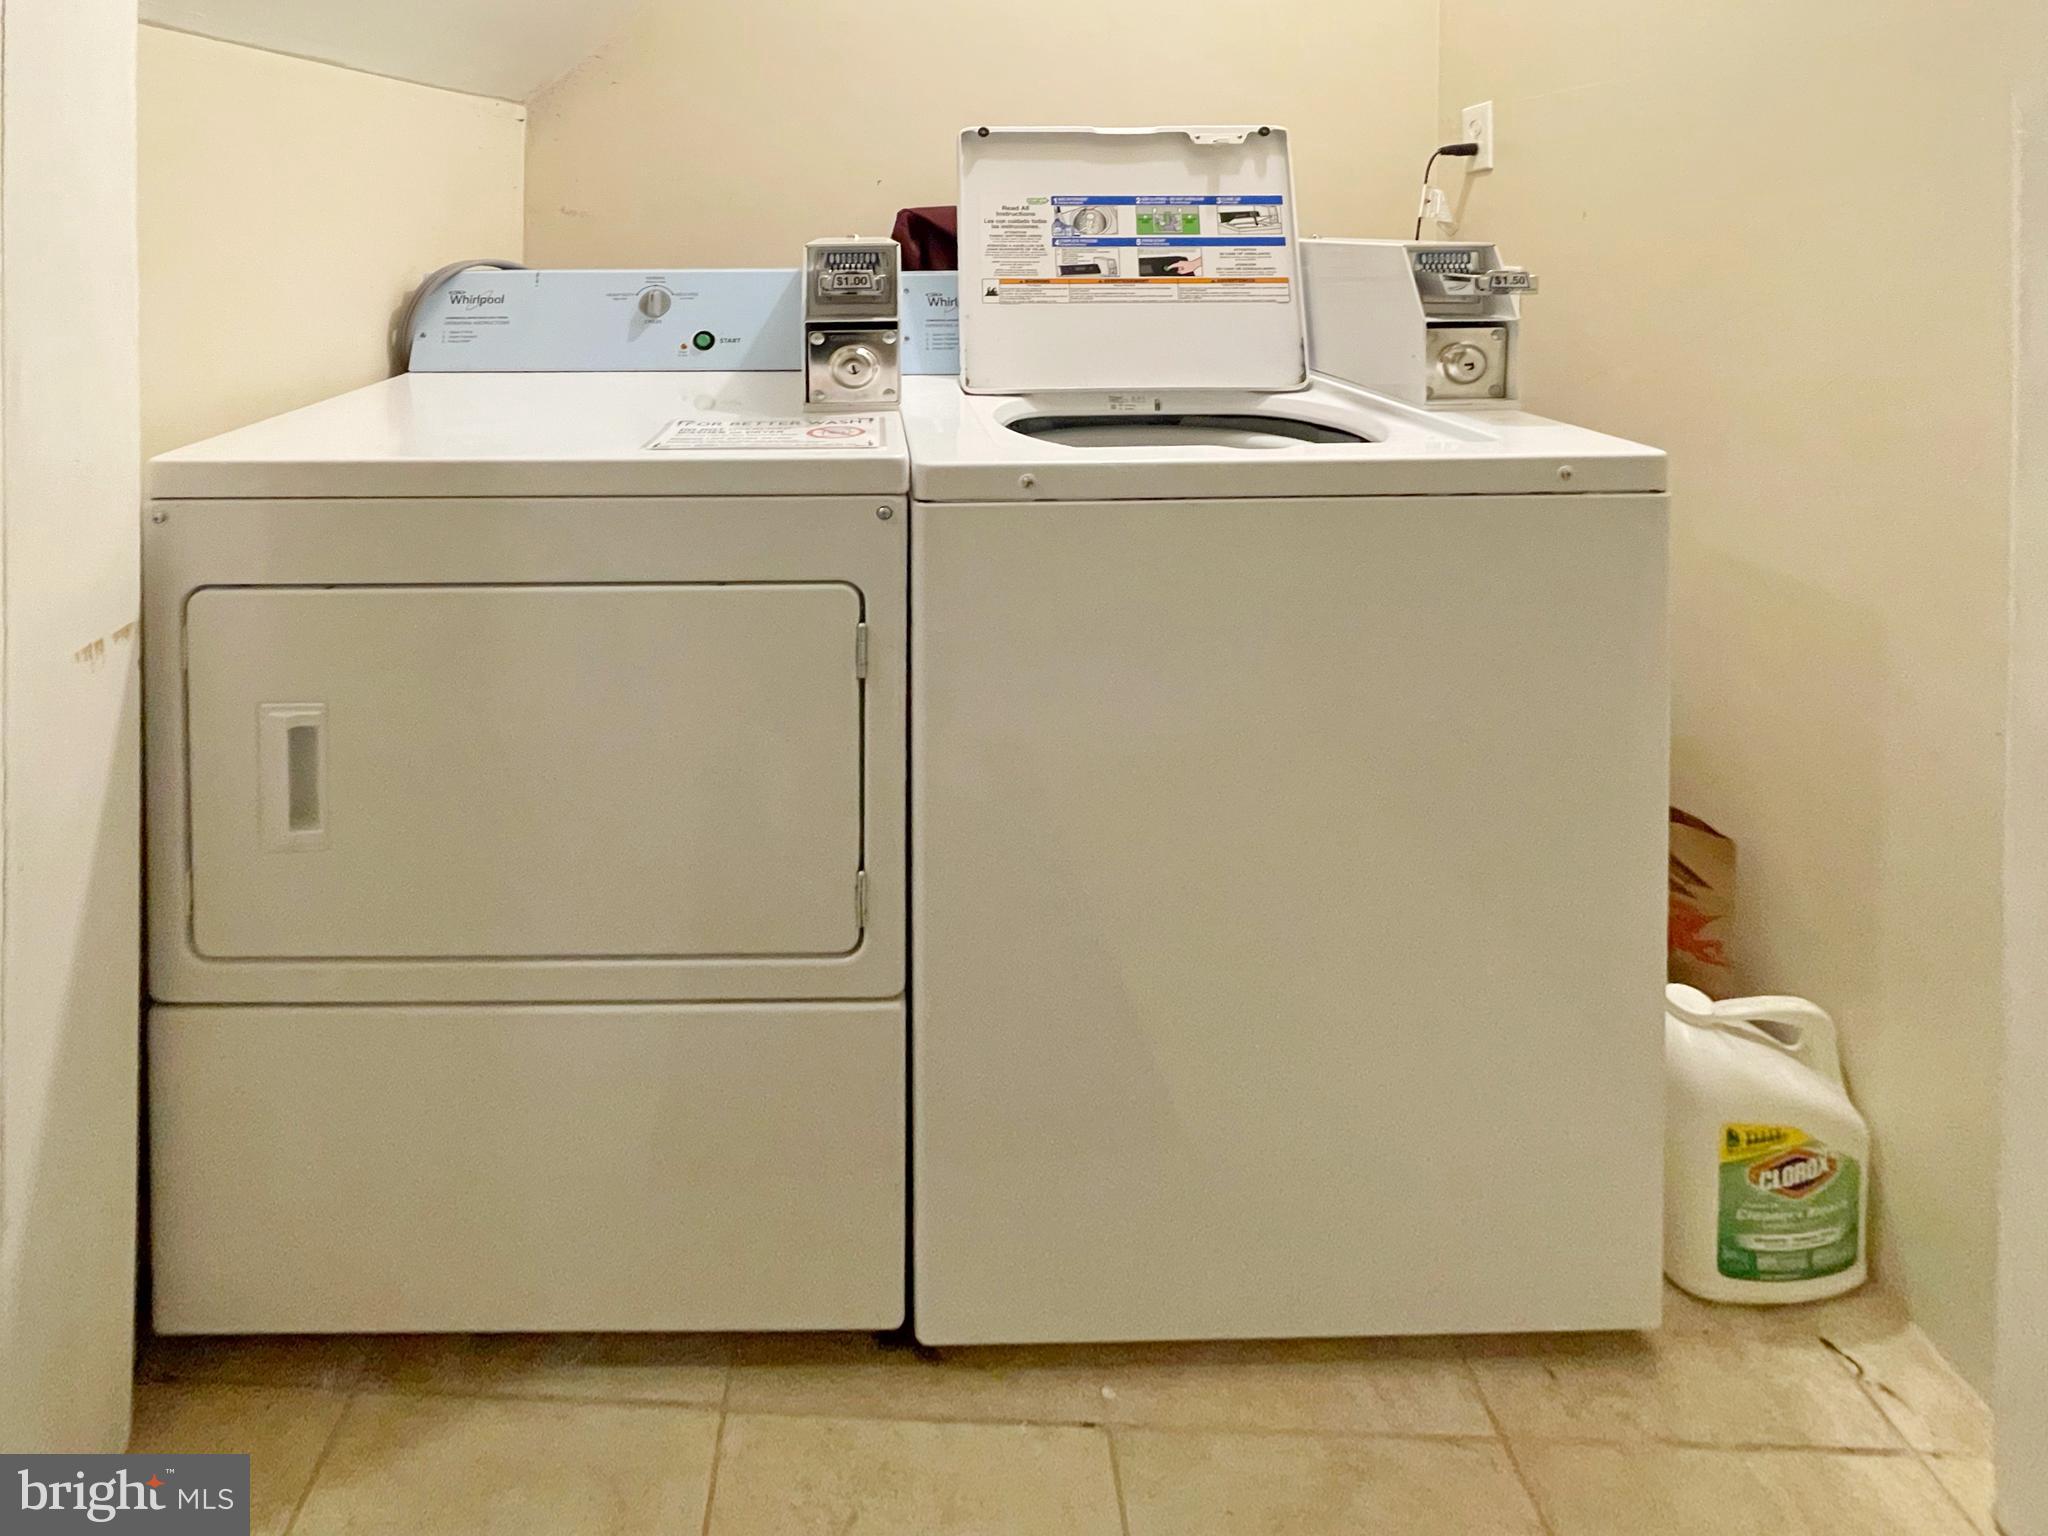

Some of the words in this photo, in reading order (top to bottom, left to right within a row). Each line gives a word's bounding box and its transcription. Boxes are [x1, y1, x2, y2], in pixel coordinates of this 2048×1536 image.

[836, 276, 868, 286] $1.00
[1495, 276, 1525, 285] $1.50
[450, 294, 505, 307] Whirlpool
[1758, 1155, 1829, 1190] CLOROX
